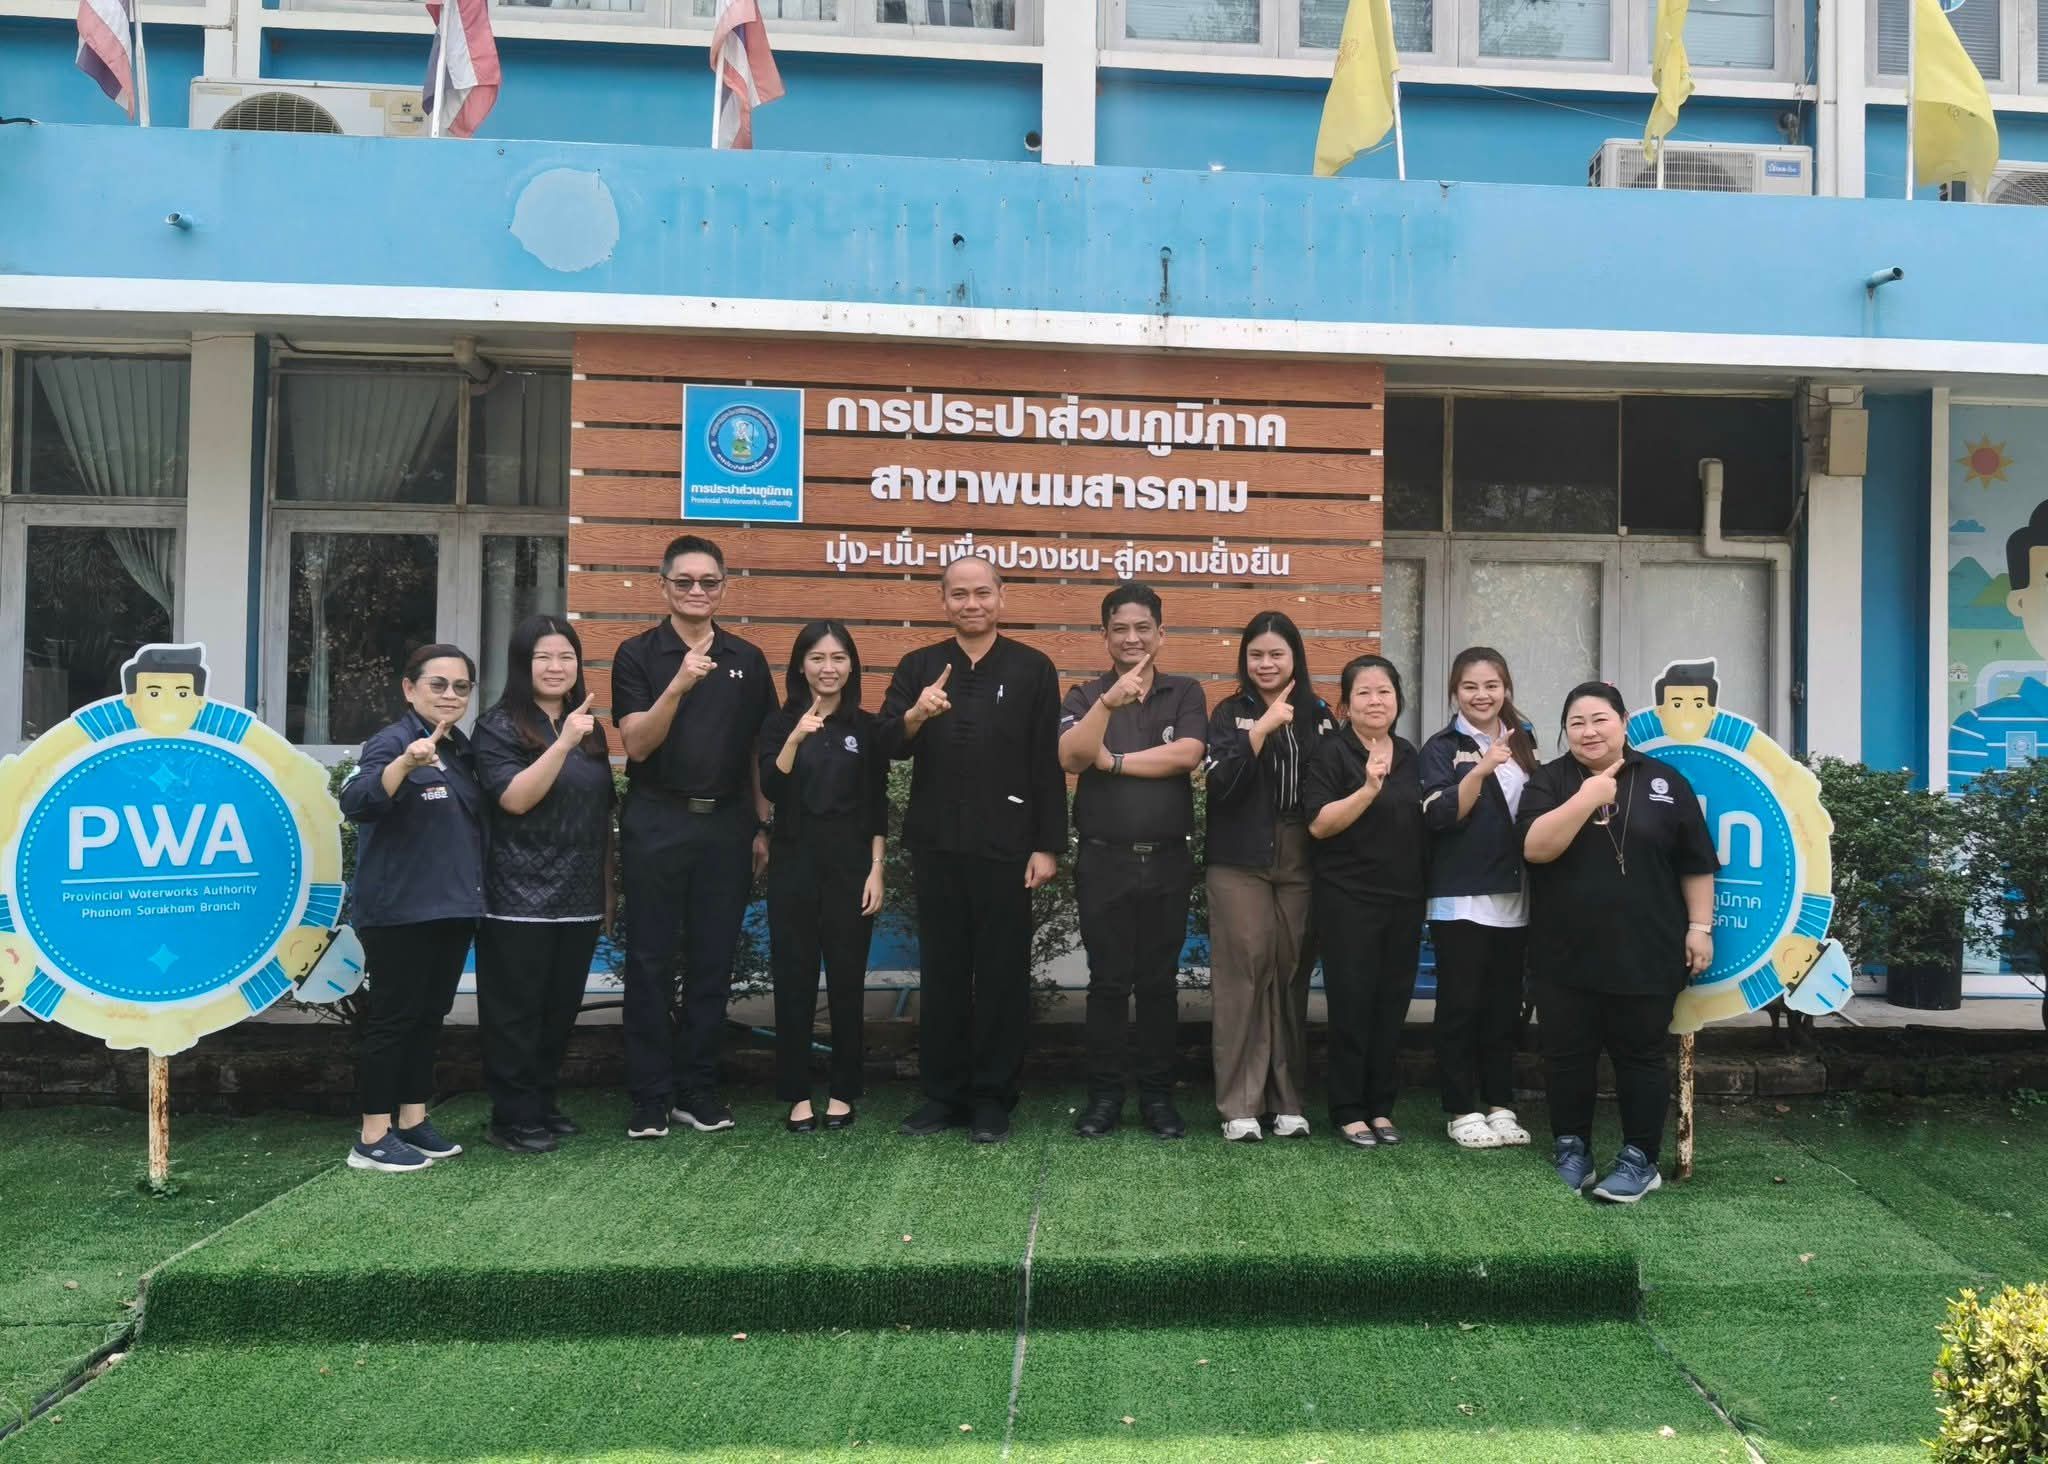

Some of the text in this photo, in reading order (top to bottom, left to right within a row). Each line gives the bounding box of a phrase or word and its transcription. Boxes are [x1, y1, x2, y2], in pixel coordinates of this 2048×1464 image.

[827, 393, 1287, 457] การประปาส่วนภูมิภาค
[871, 465, 1248, 513] สาขาพนมสารคาม
[68, 803, 254, 870] PWA
[63, 884, 257, 902] Provincial Waterworks Authority
[82, 900, 240, 919] Phanom Sarakham Branch
